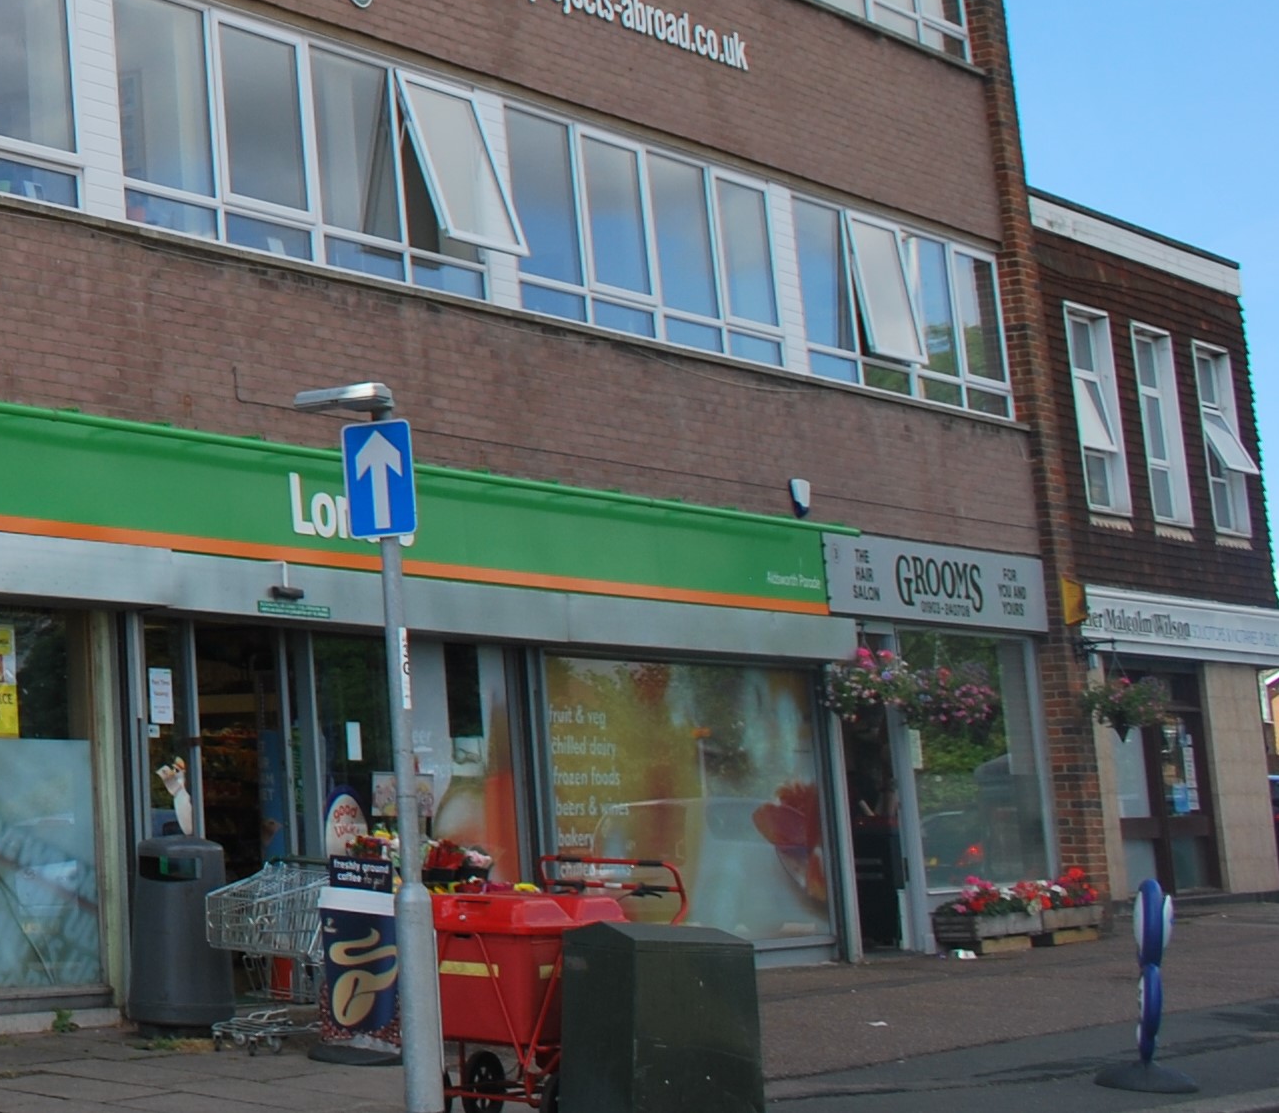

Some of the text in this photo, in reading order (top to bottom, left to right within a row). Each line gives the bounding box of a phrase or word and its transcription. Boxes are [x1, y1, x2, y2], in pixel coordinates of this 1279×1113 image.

[854, 548, 870, 564] THE
[855, 567, 874, 583] HAIR
[1002, 567, 1018, 582] FOR
[895, 554, 984, 613] GROOMS
[997, 584, 1027, 600] YOU AND
[853, 585, 881, 602] SALON
[1001, 601, 1025, 617] YOURS
[1105, 608, 1153, 635] Malcolm
[1152, 614, 1191, 641] Wilson
[549, 704, 606, 730] fruit & veg
[551, 736, 617, 760] chilled dairy
[553, 767, 620, 786] frozen foods
[555, 796, 629, 816] beers & wines
[558, 827, 594, 851] bakery
[333, 859, 389, 874] freshly ground
[337, 872, 361, 882] coffee
